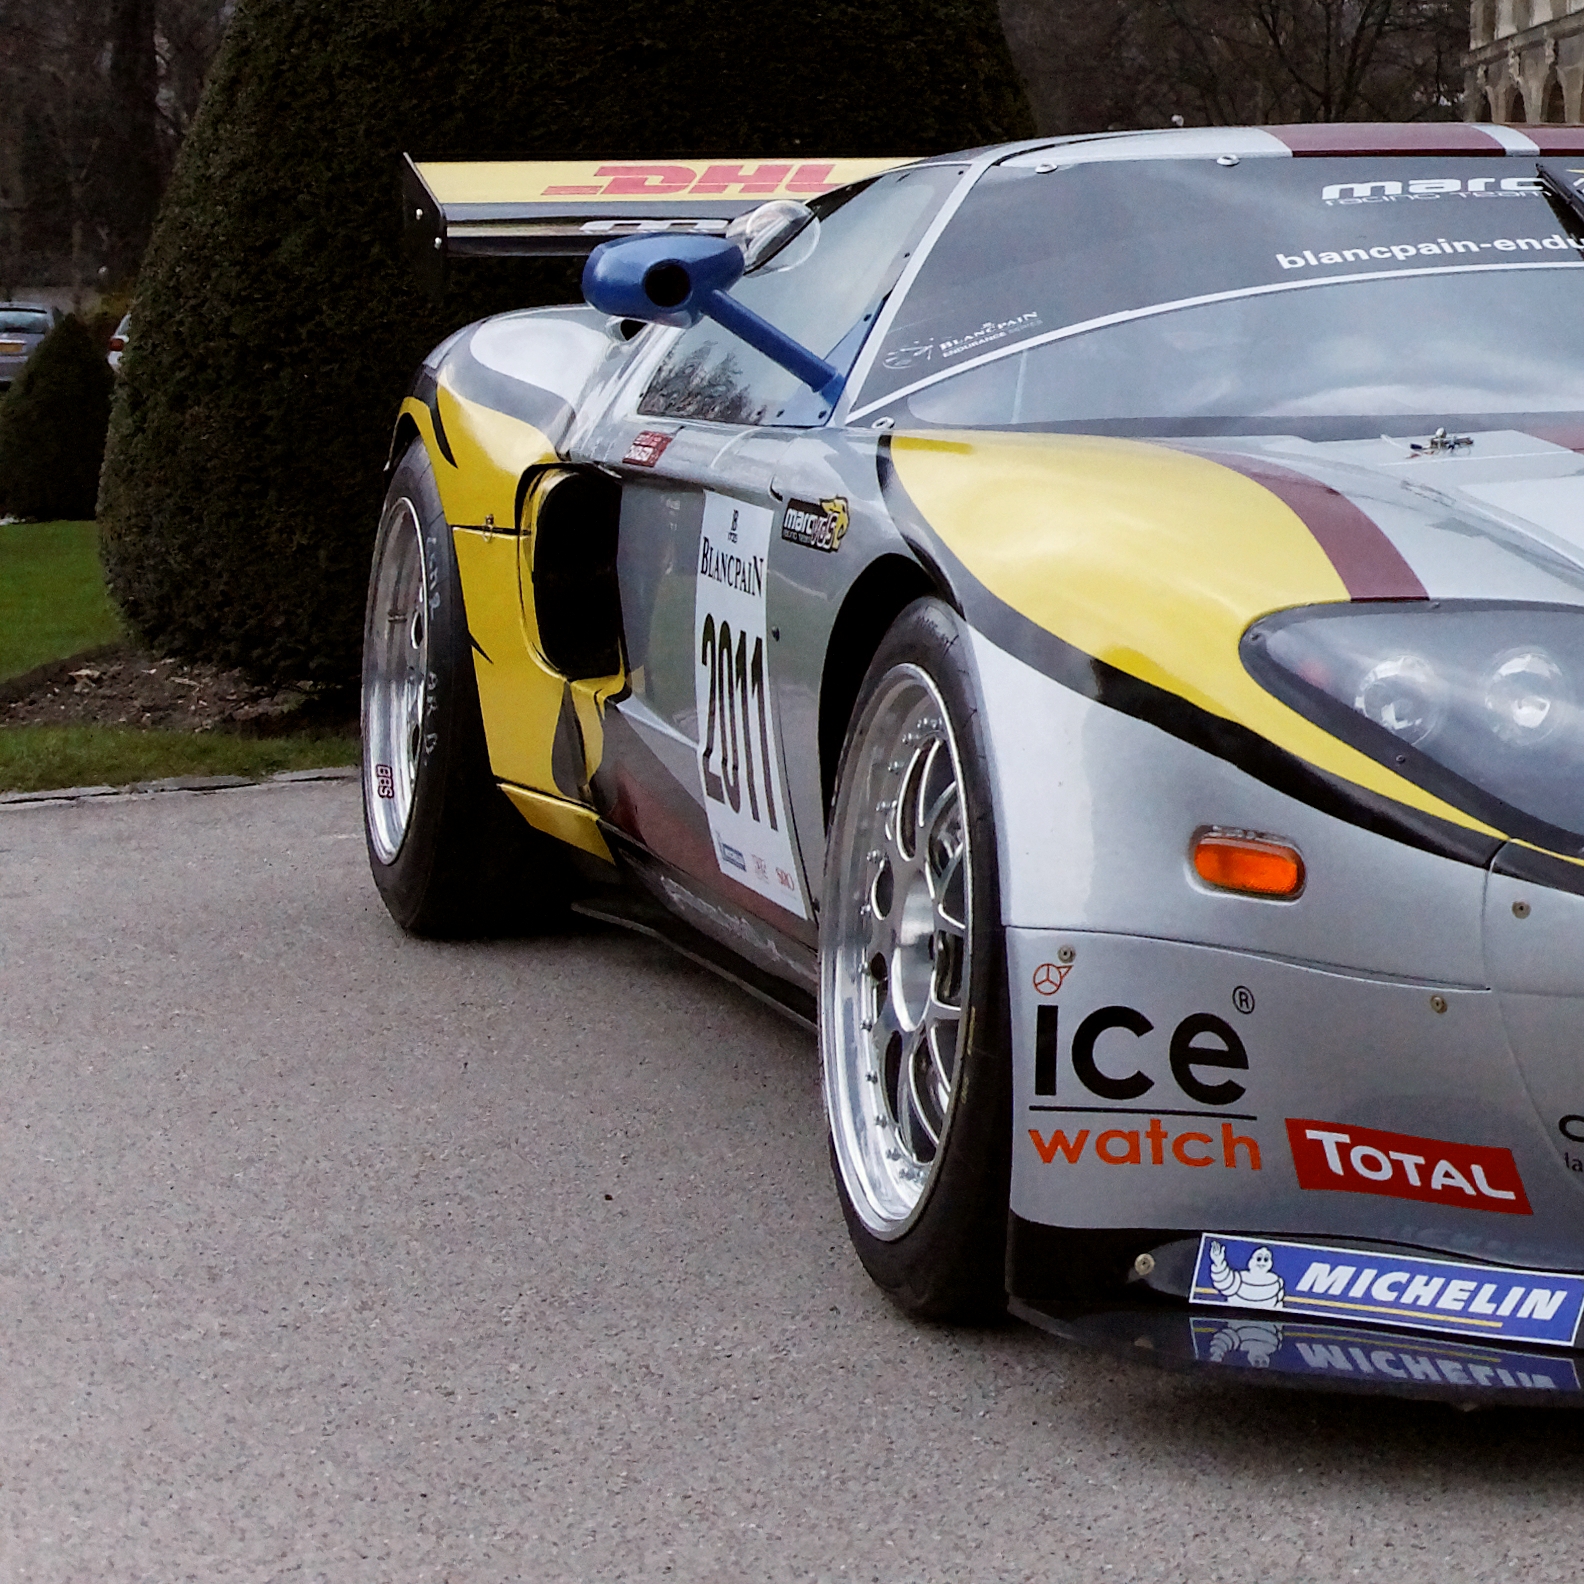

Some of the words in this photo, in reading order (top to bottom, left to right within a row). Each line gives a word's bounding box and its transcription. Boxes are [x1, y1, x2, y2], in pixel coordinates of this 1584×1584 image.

[594, 164, 845, 195] DHL
[1322, 177, 1552, 200] marc
[701, 536, 764, 597] BLANCPAIN
[702, 613, 778, 831] 2011
[376, 764, 394, 799] BBS
[1028, 1118, 1261, 1170] watch
[1305, 1130, 1516, 1200] TOTAL
[1564, 1152, 1583, 1173] la
[1296, 1262, 1567, 1320] MICHELIN
